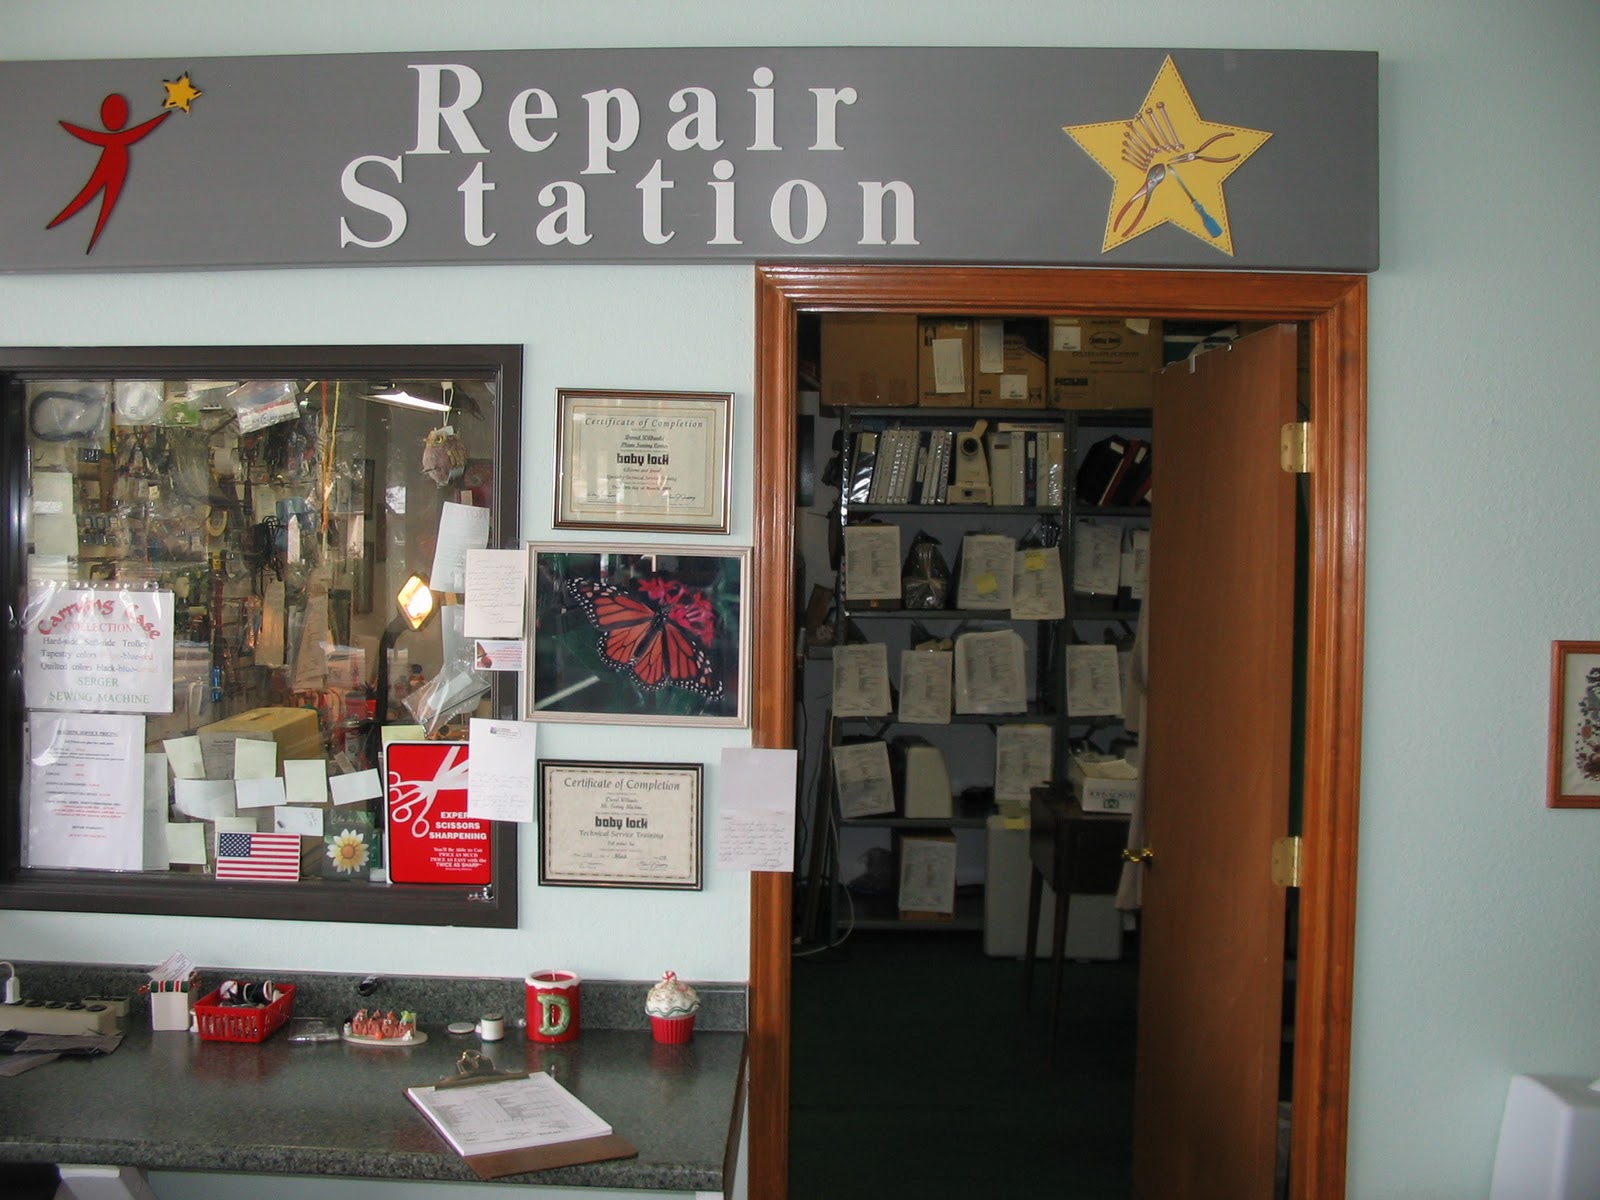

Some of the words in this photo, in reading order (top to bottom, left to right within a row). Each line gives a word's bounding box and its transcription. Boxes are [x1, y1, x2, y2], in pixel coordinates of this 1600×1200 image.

[405, 63, 858, 175] Repair
[339, 155, 921, 249] Station
[584, 417, 635, 428] Certificate
[638, 418, 649, 429] of
[651, 419, 703, 429] Completion
[617, 453, 645, 467] baby
[647, 453, 669, 465] lock
[64, 622, 133, 633] COLLECTION
[125, 604, 161, 640] Case
[122, 639, 149, 649] Trolley
[41, 650, 72, 660] Tapestry
[76, 651, 97, 659] colors
[40, 662, 67, 671] Quilted
[71, 663, 93, 671] colors
[77, 677, 119, 687] SERGER
[49, 691, 93, 702] SEWING
[97, 693, 150, 704] MACHINE
[564, 777, 612, 790] Certificate
[614, 778, 624, 790] of
[626, 779, 680, 791] Completion
[440, 811, 475, 819] EXPER
[435, 821, 481, 830] SCISSORS
[595, 816, 623, 830] baby
[625, 817, 648, 829] lock
[428, 832, 488, 841] SHARPENING
[610, 830, 634, 838] Service
[635, 831, 664, 840] Training
[537, 994, 571, 1036] D
